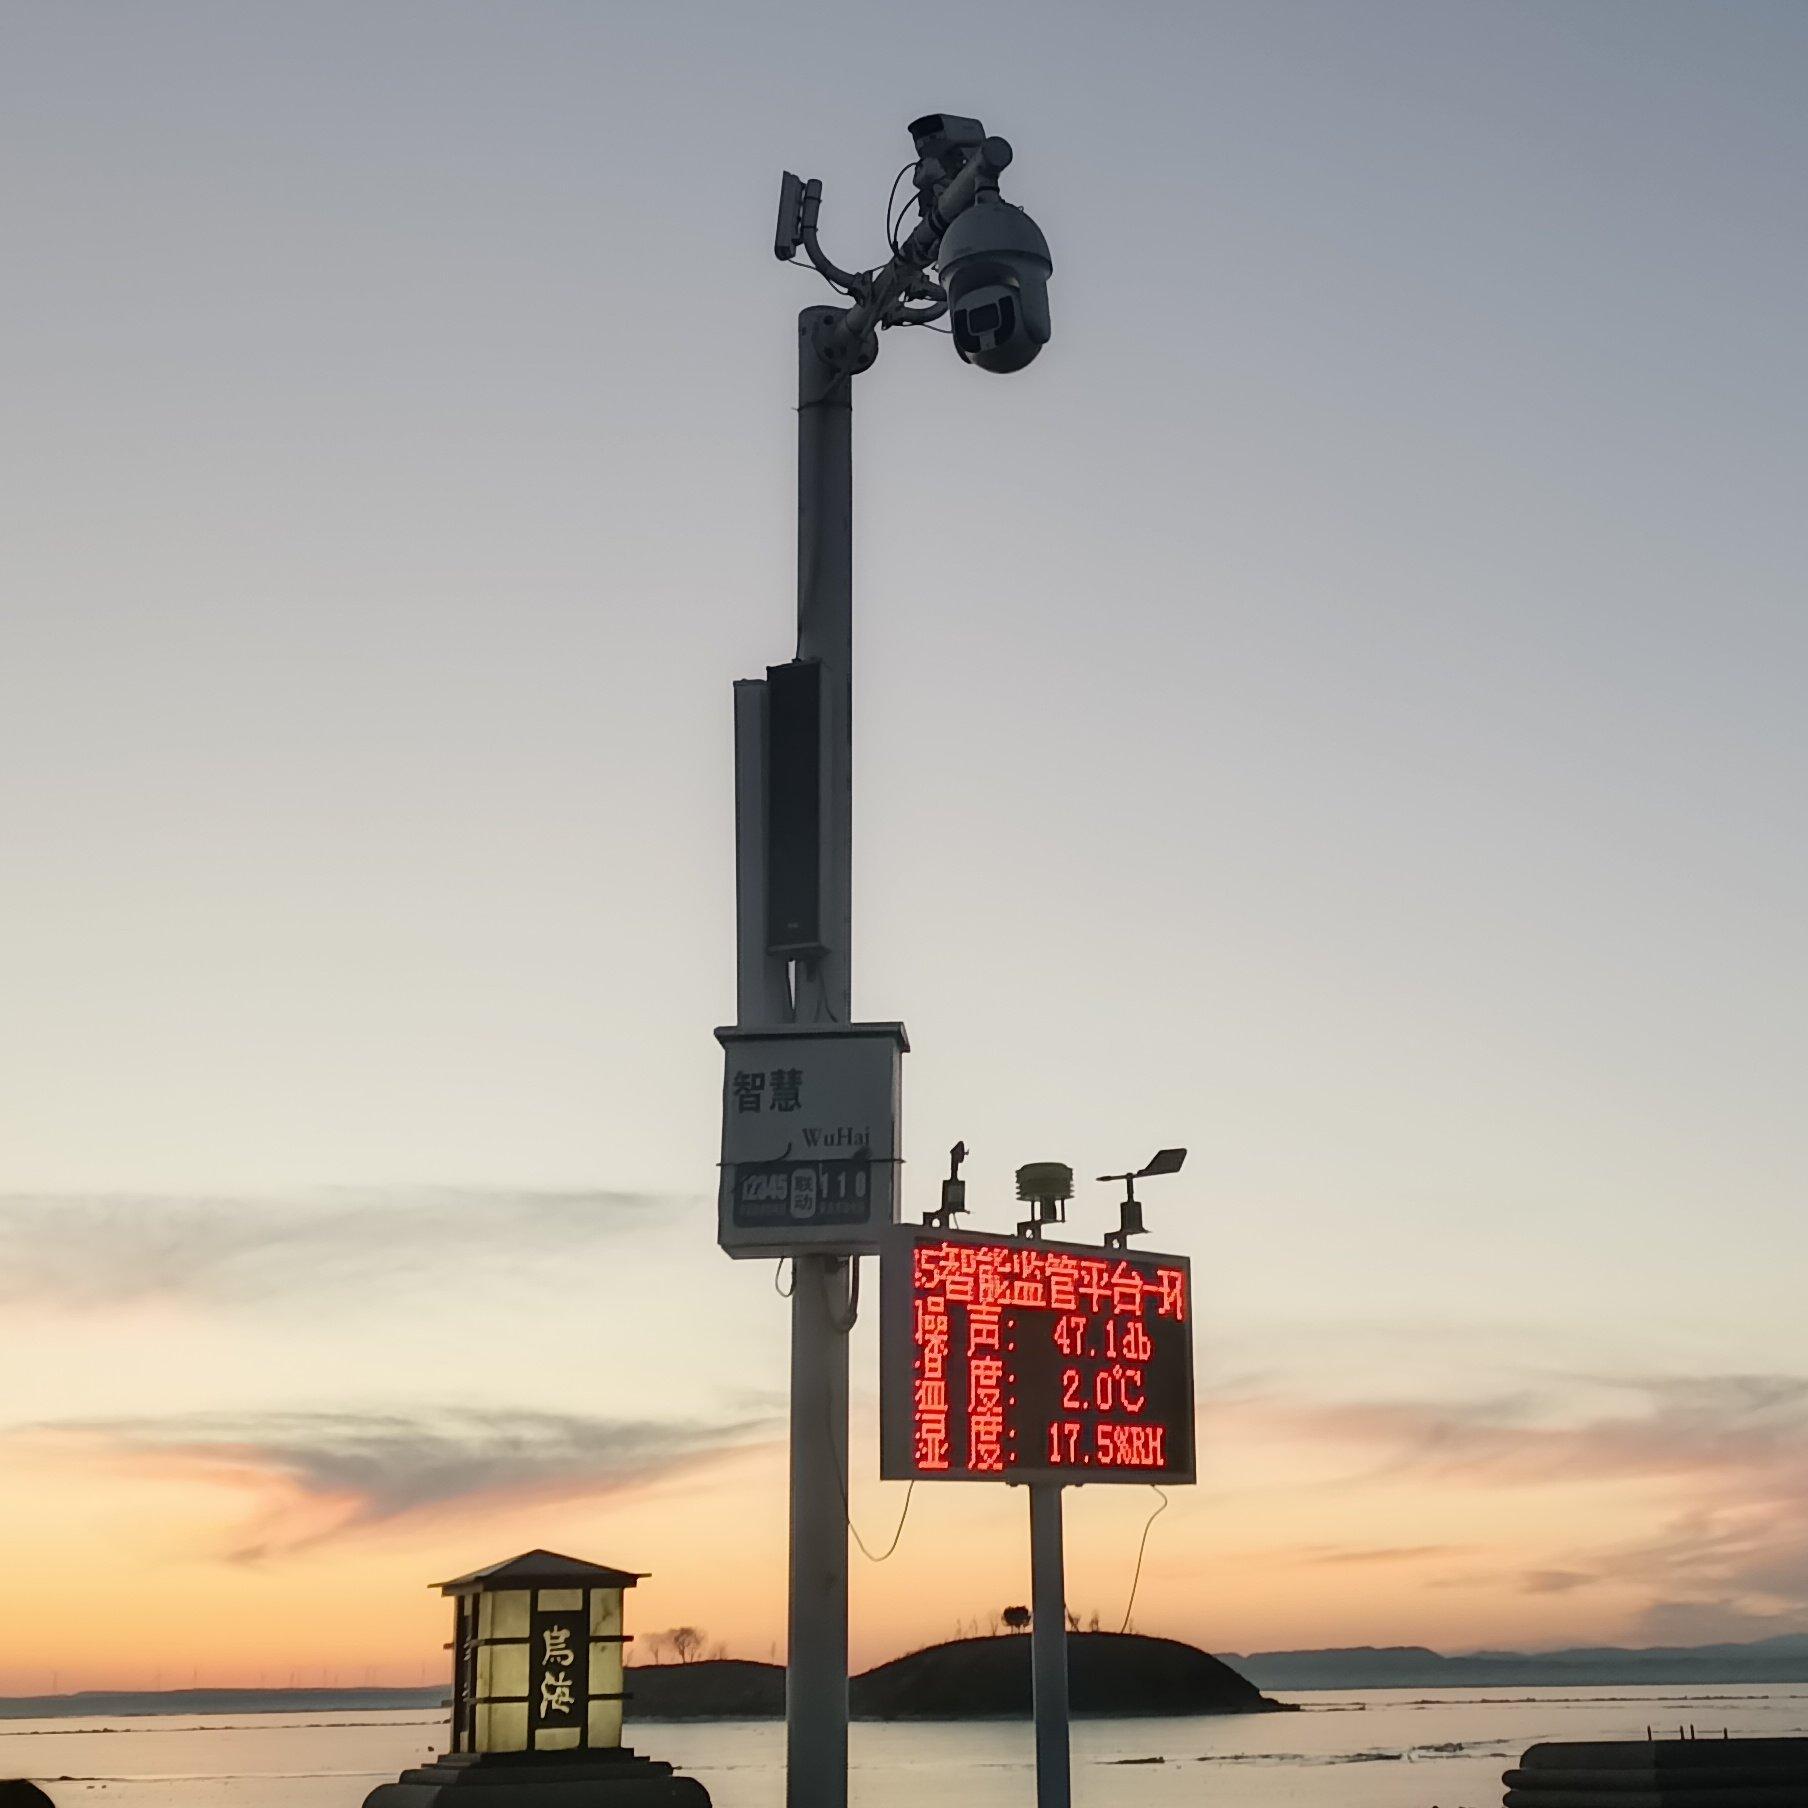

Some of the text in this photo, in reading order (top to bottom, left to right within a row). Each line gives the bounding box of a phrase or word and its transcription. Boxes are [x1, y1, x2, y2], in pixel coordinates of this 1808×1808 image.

[734, 1068, 803, 1114] 智慧
[802, 1126, 871, 1150] WuHai
[819, 1170, 867, 1199] 110
[1054, 1315, 1151, 1361] 47.1db
[1050, 1422, 1164, 1466] 17.5%RH
